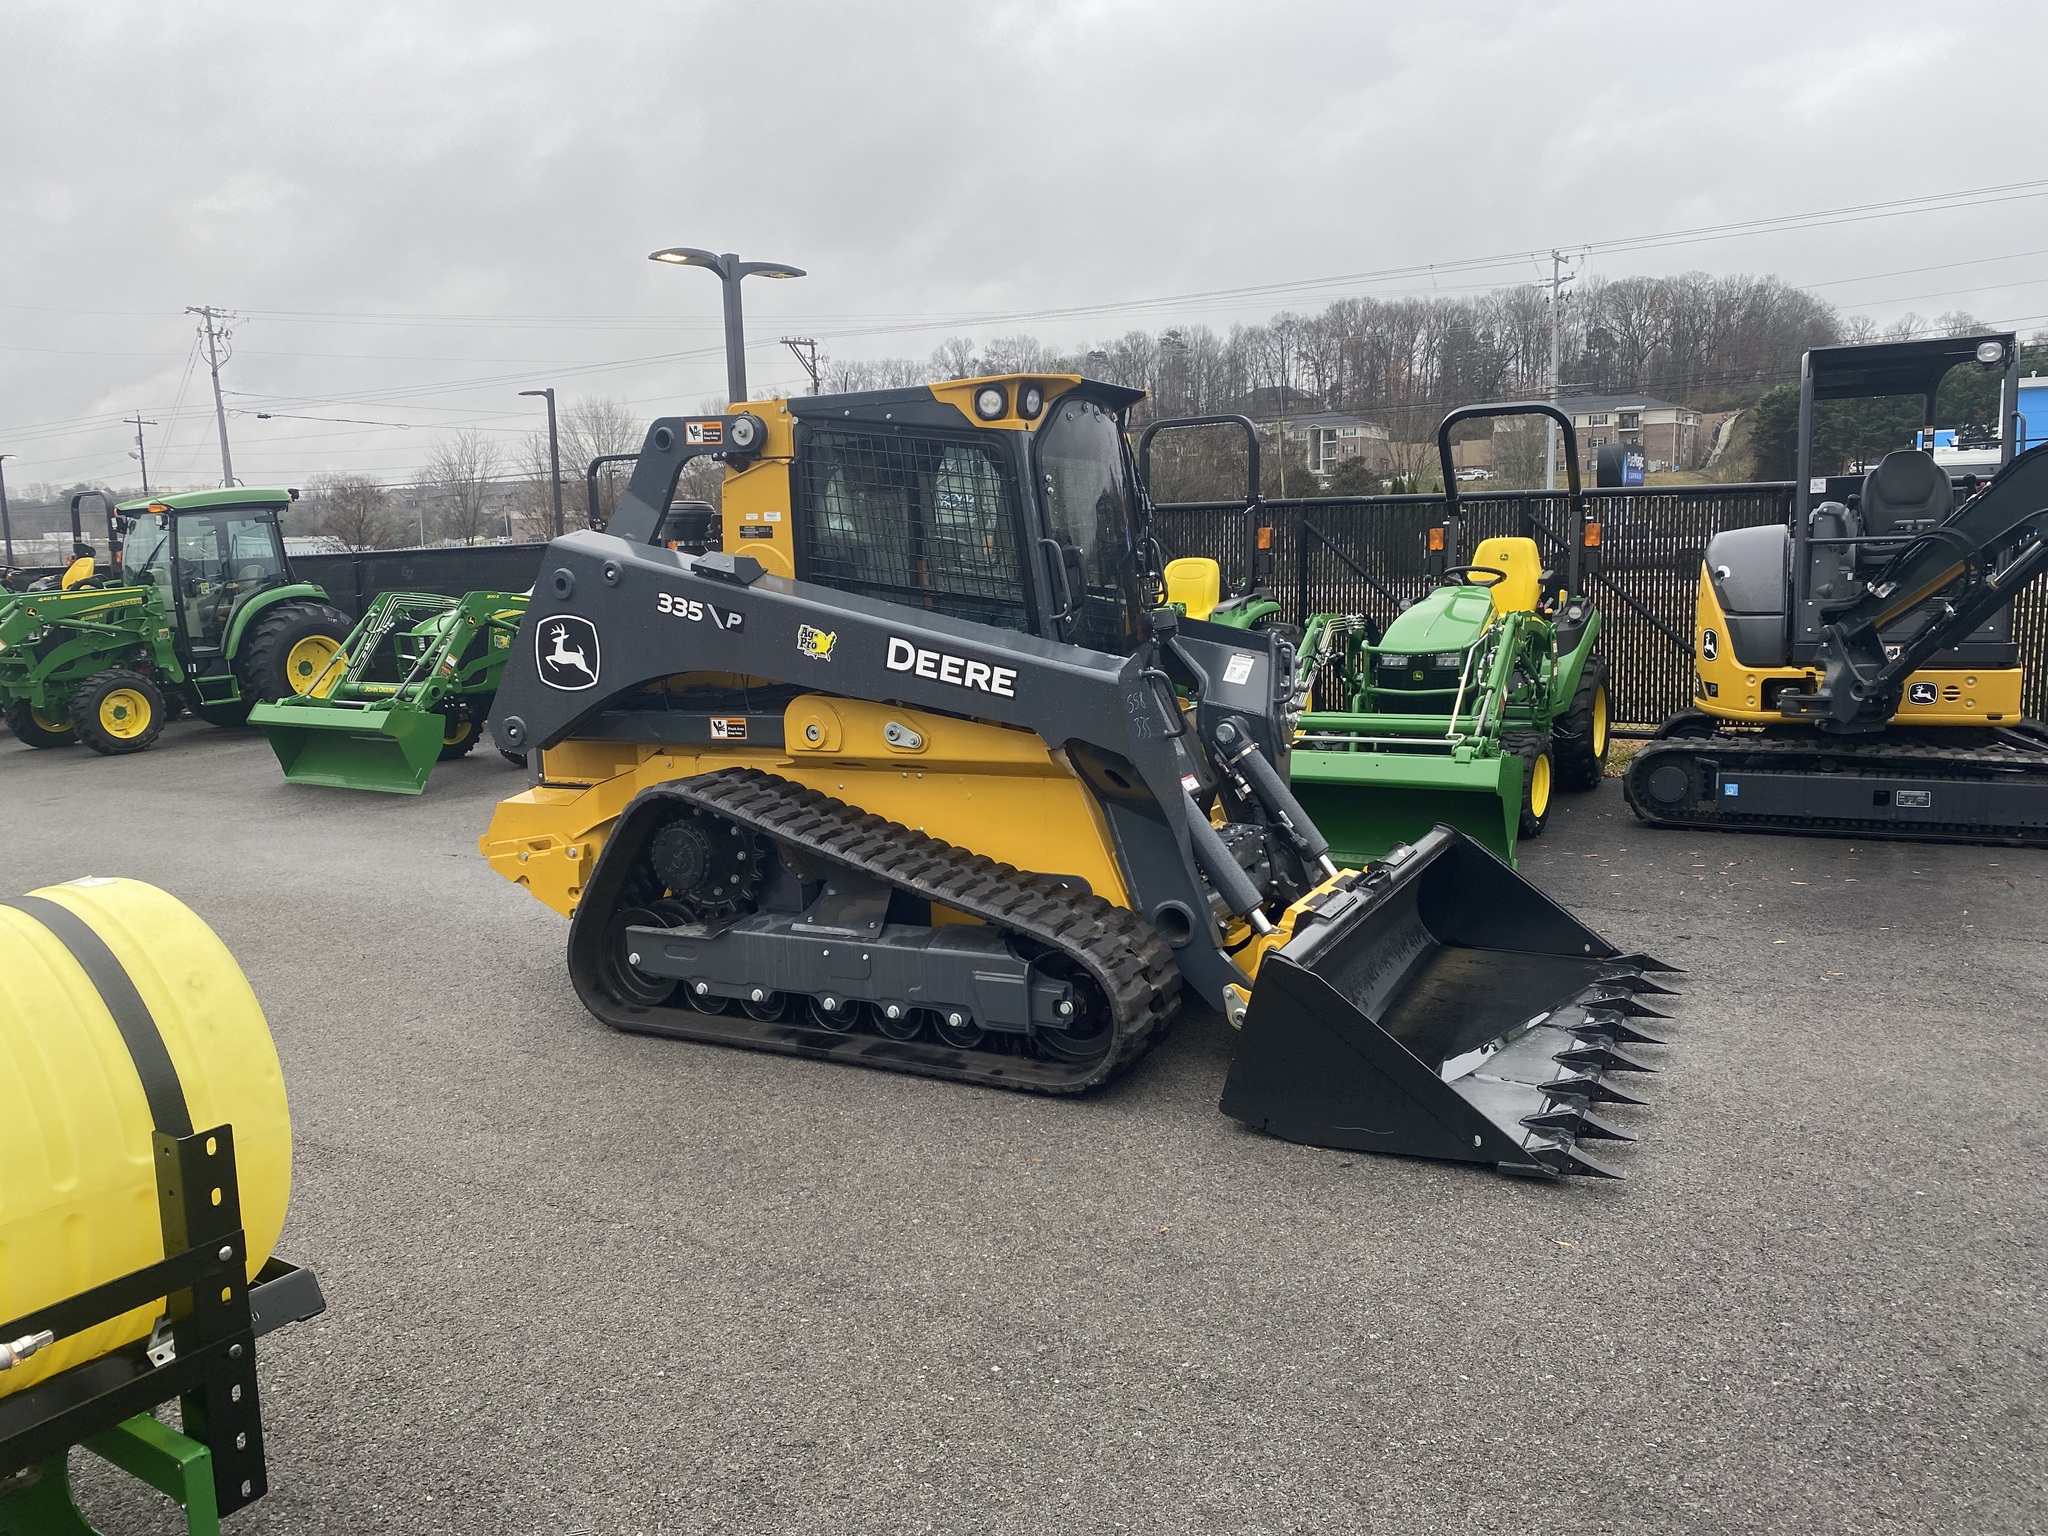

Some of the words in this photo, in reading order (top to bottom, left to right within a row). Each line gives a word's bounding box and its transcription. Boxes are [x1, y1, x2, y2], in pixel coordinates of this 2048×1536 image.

[657, 592, 703, 622] 335
[726, 612, 742, 629] P
[887, 636, 1017, 697] DEERE
